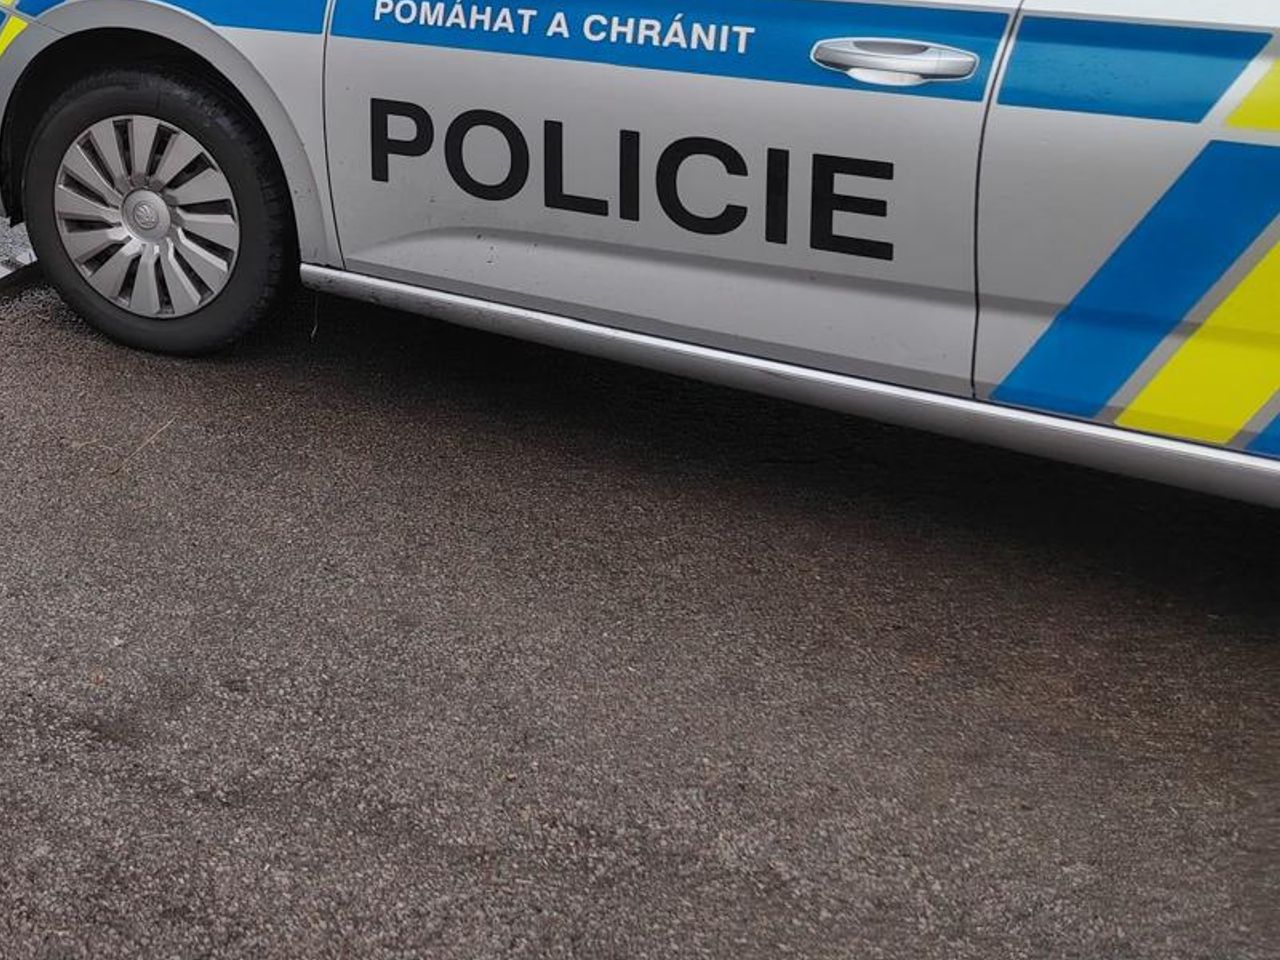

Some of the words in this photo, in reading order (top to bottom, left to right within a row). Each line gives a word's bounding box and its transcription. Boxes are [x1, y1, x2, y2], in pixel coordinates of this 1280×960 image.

[546, 12, 570, 39] A
[583, 12, 756, 54] CHRÁNIT
[369, 97, 894, 261] POLICIE
